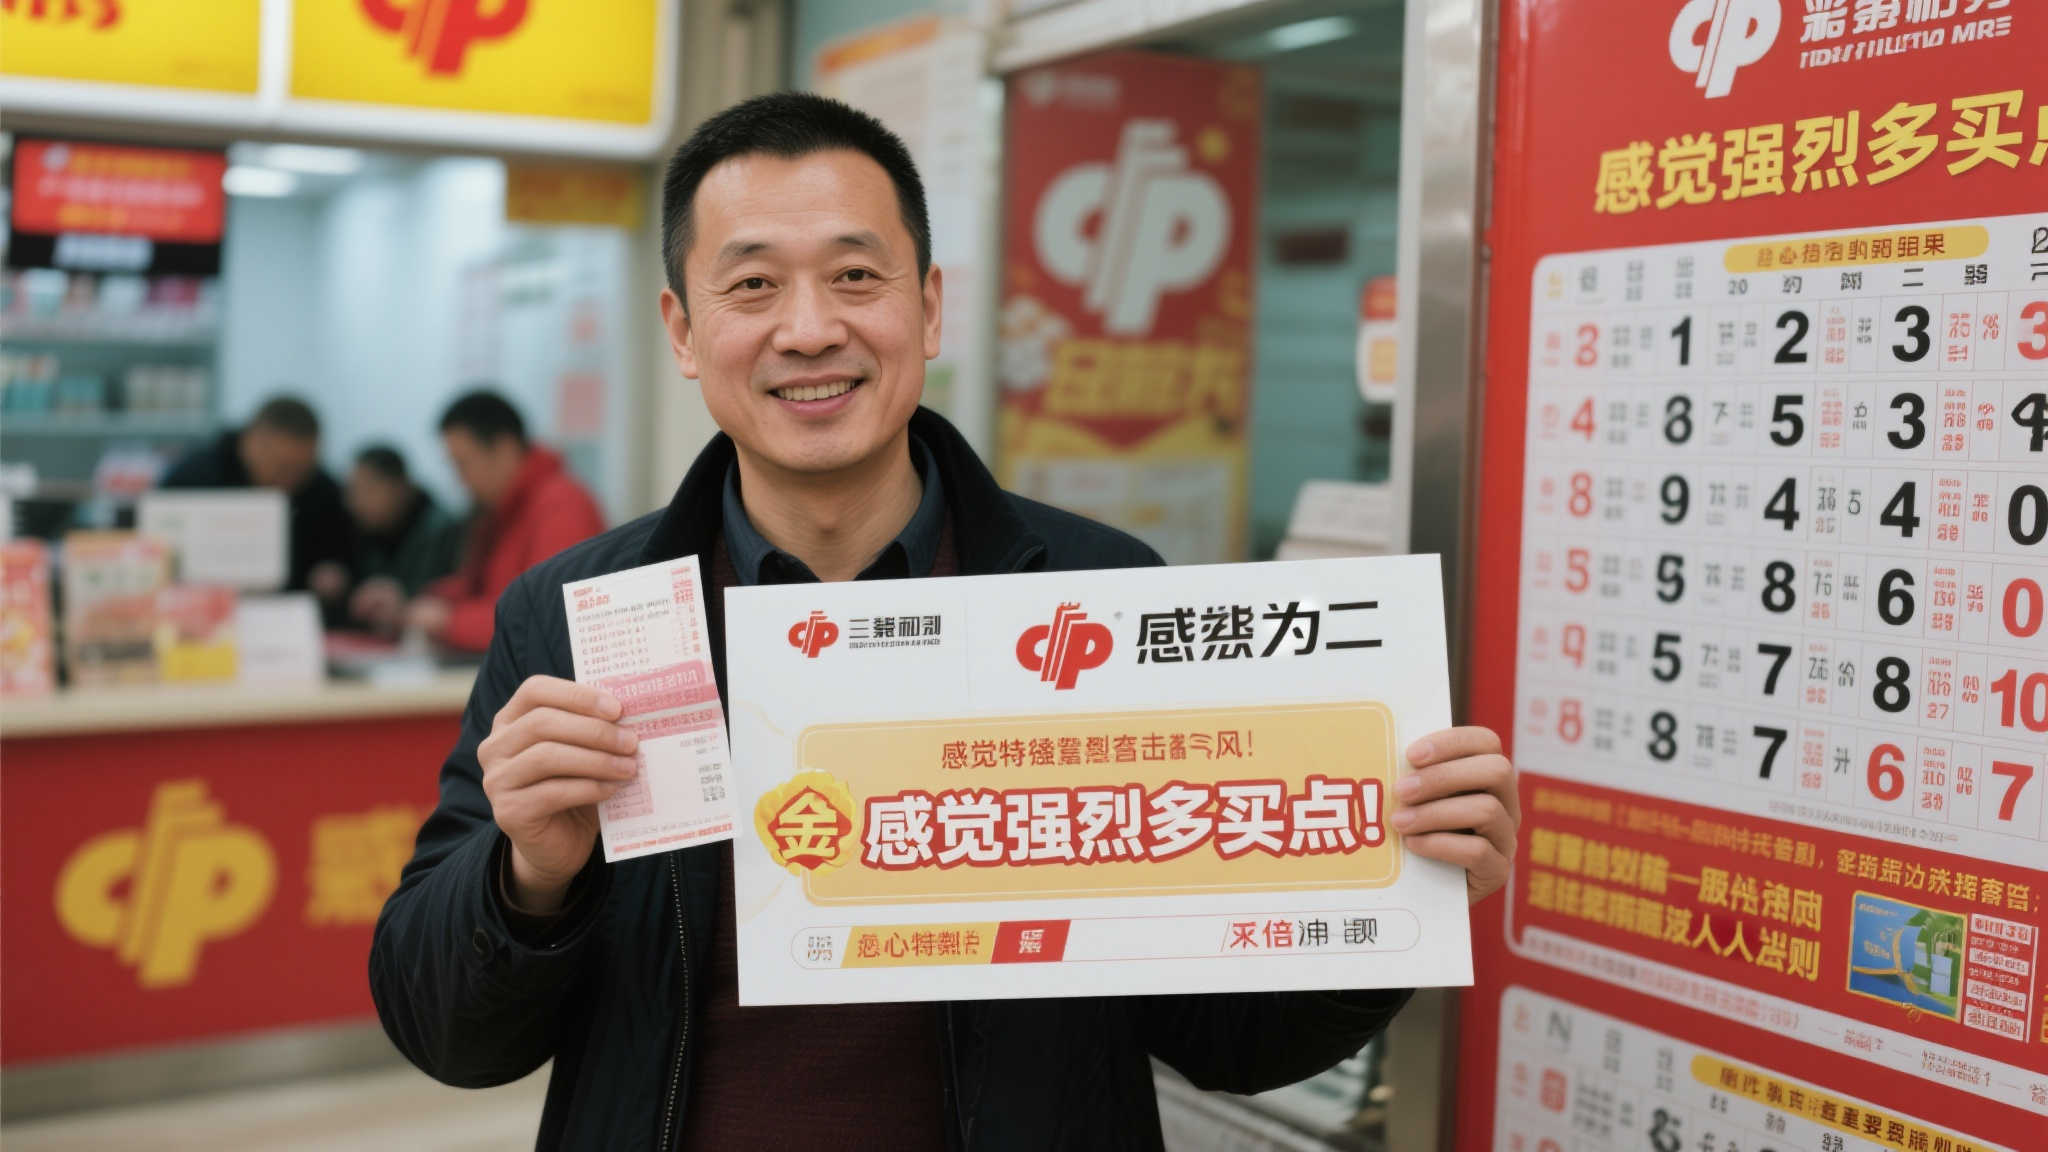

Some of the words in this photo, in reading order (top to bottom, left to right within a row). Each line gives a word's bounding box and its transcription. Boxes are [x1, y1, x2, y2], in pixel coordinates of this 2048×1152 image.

[1671, 316, 1692, 366] 1
[1774, 310, 1809, 364] 2
[1892, 305, 1931, 363] 3
[1569, 398, 1597, 442] 4
[1664, 395, 1693, 444] 8
[1770, 394, 1804, 447] 5
[1887, 392, 1926, 450] 3
[1567, 471, 1593, 518] 8
[1660, 474, 1690, 525] 9
[1764, 477, 1800, 531] 4
[1880, 481, 1921, 538] 4
[2008, 484, 2048, 546] 0
[1761, 560, 1796, 613] 8
[1877, 568, 1915, 626] 6
[2002, 577, 2045, 639] 0
[1652, 632, 1682, 683] 5
[1757, 643, 1792, 696] 7
[1872, 656, 1911, 713] 8
[1990, 668, 2048, 734] 10
[1753, 725, 1788, 779] 7
[1866, 742, 1907, 803] 6
[1992, 760, 2035, 823] 7
[776, 792, 842, 858] 金
[865, 781, 1382, 866] 感觉强烈多买点!
